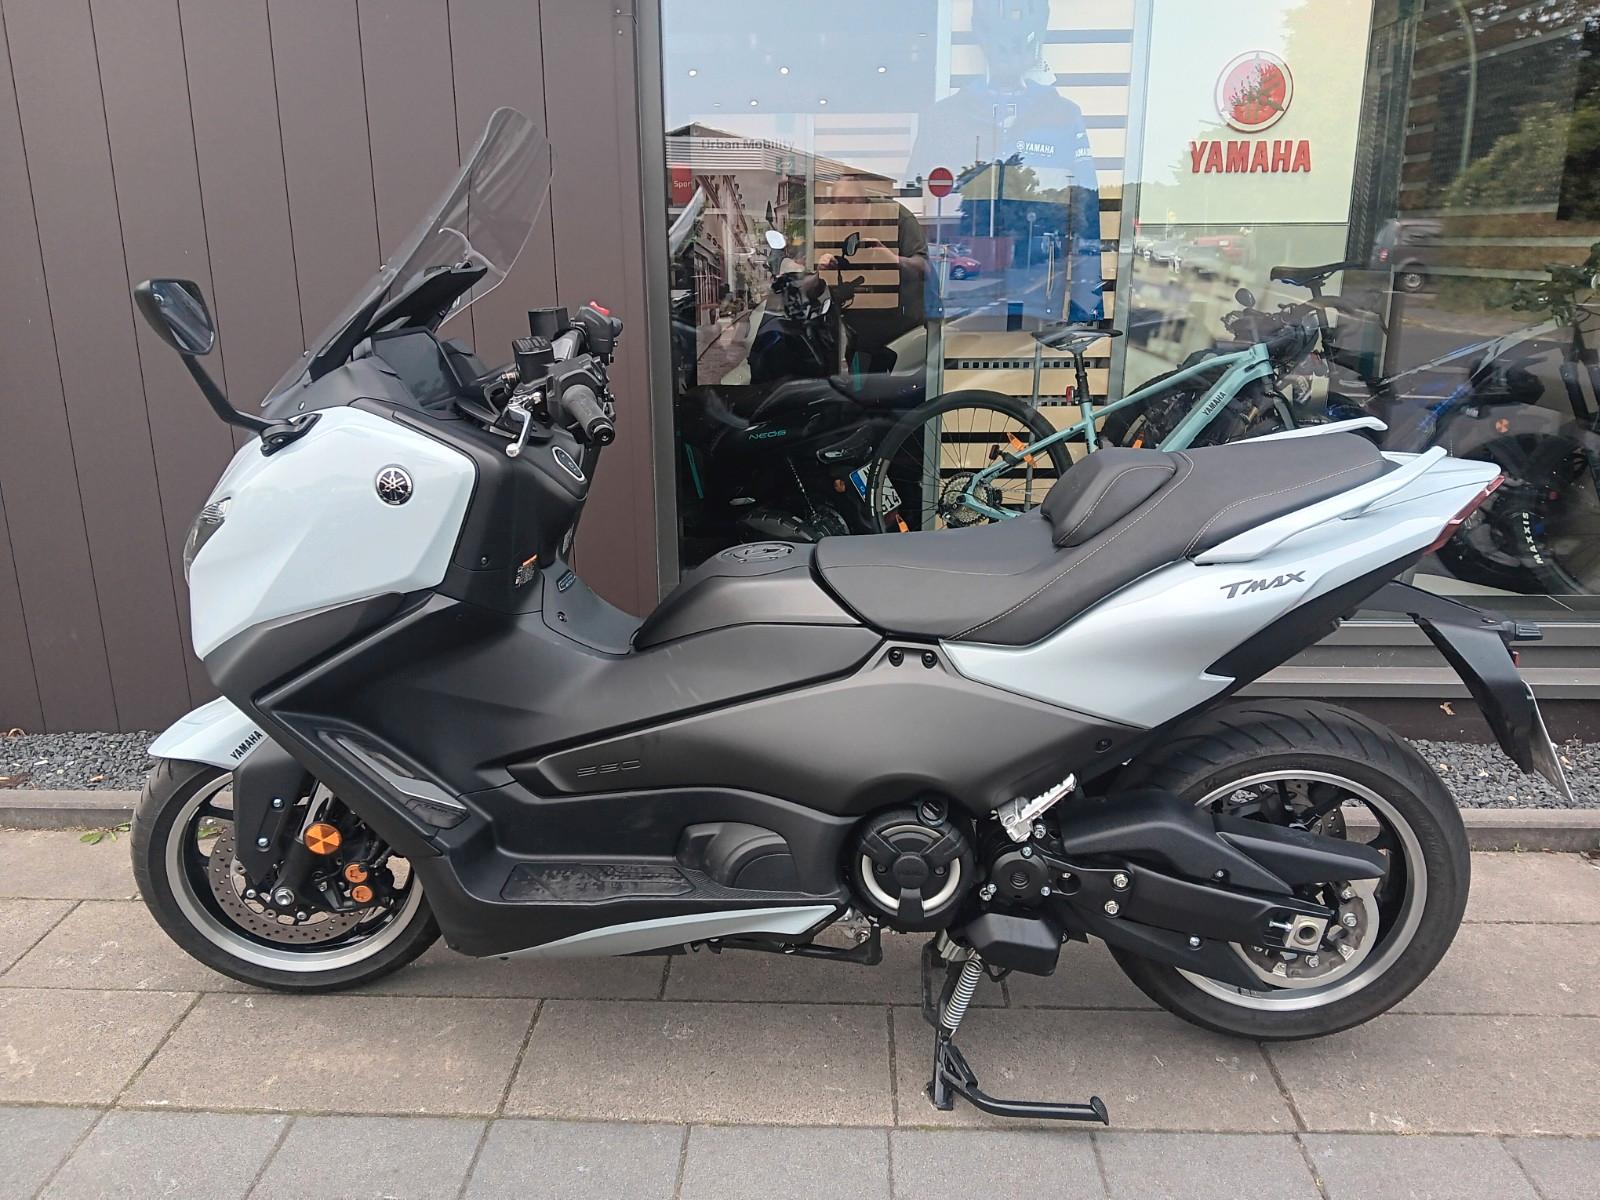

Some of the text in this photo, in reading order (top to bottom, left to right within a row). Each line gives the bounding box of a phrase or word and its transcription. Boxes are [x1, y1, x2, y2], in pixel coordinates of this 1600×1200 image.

[701, 138, 740, 149] Urban
[1025, 142, 1055, 154] YAMAHA
[1190, 140, 1311, 173] YAMAHA
[1202, 391, 1226, 416] YAMAHA
[1522, 511, 1544, 564] MAXXIS
[1220, 570, 1306, 599] TMAX
[230, 730, 263, 760] YAMAHA
